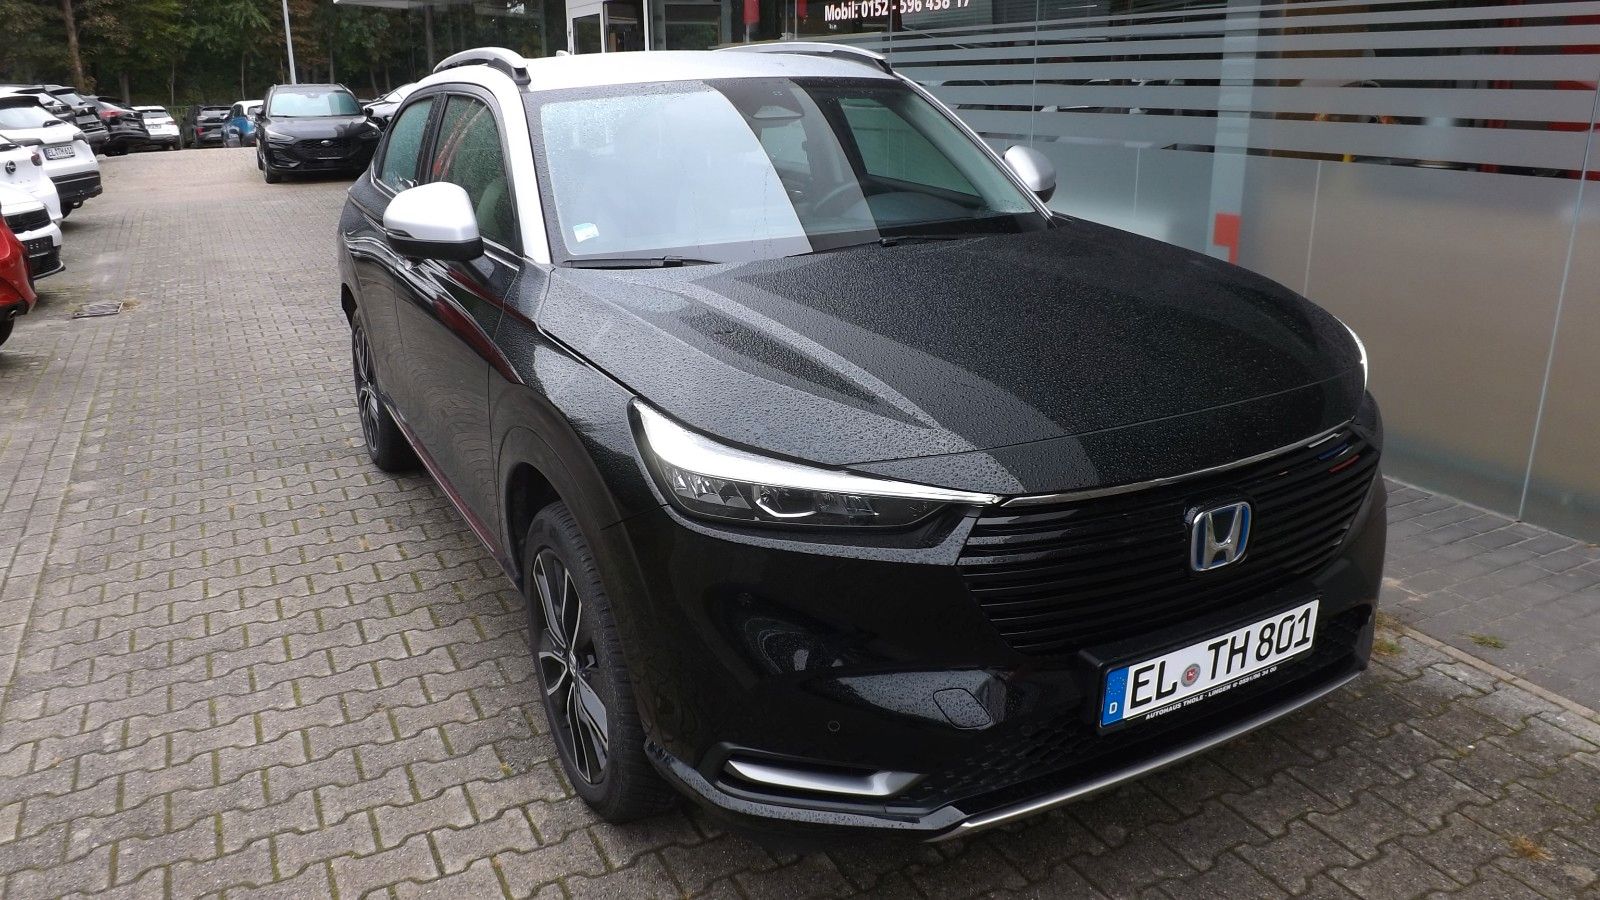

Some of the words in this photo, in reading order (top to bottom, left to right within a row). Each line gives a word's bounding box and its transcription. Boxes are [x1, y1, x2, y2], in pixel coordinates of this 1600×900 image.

[824, 0, 858, 21] Mobil:
[861, 0, 889, 17] 0152
[1108, 701, 1118, 715] D
[1130, 660, 1178, 709] EL
[1207, 630, 1251, 680] TH
[1255, 607, 1311, 662] 801
[1145, 702, 1182, 720] AUTOHAUS
[1183, 694, 1204, 707] THOLE
[1208, 685, 1231, 697] LINGEN
